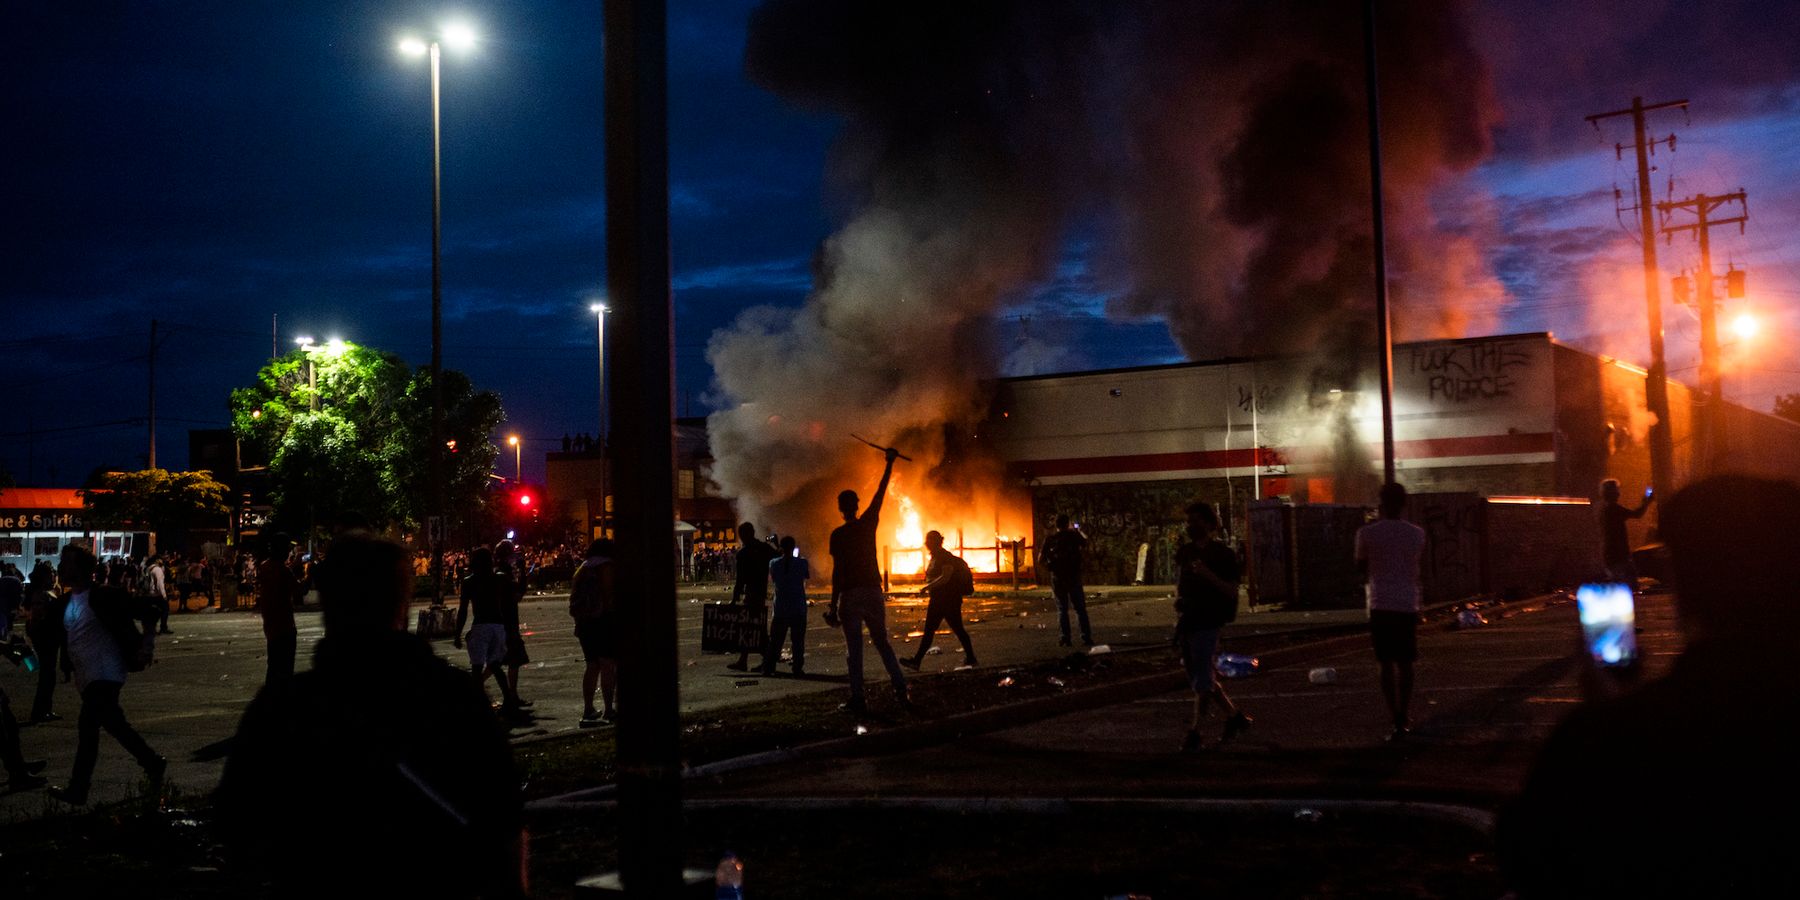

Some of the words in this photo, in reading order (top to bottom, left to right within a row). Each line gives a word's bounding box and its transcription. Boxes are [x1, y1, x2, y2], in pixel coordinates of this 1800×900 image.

[1410, 348, 1472, 377] FUCK
[1468, 342, 1531, 374] THE
[1429, 376, 1515, 404] POLICE
[17, 514, 29, 529] &
[32, 513, 82, 530] Spirits
